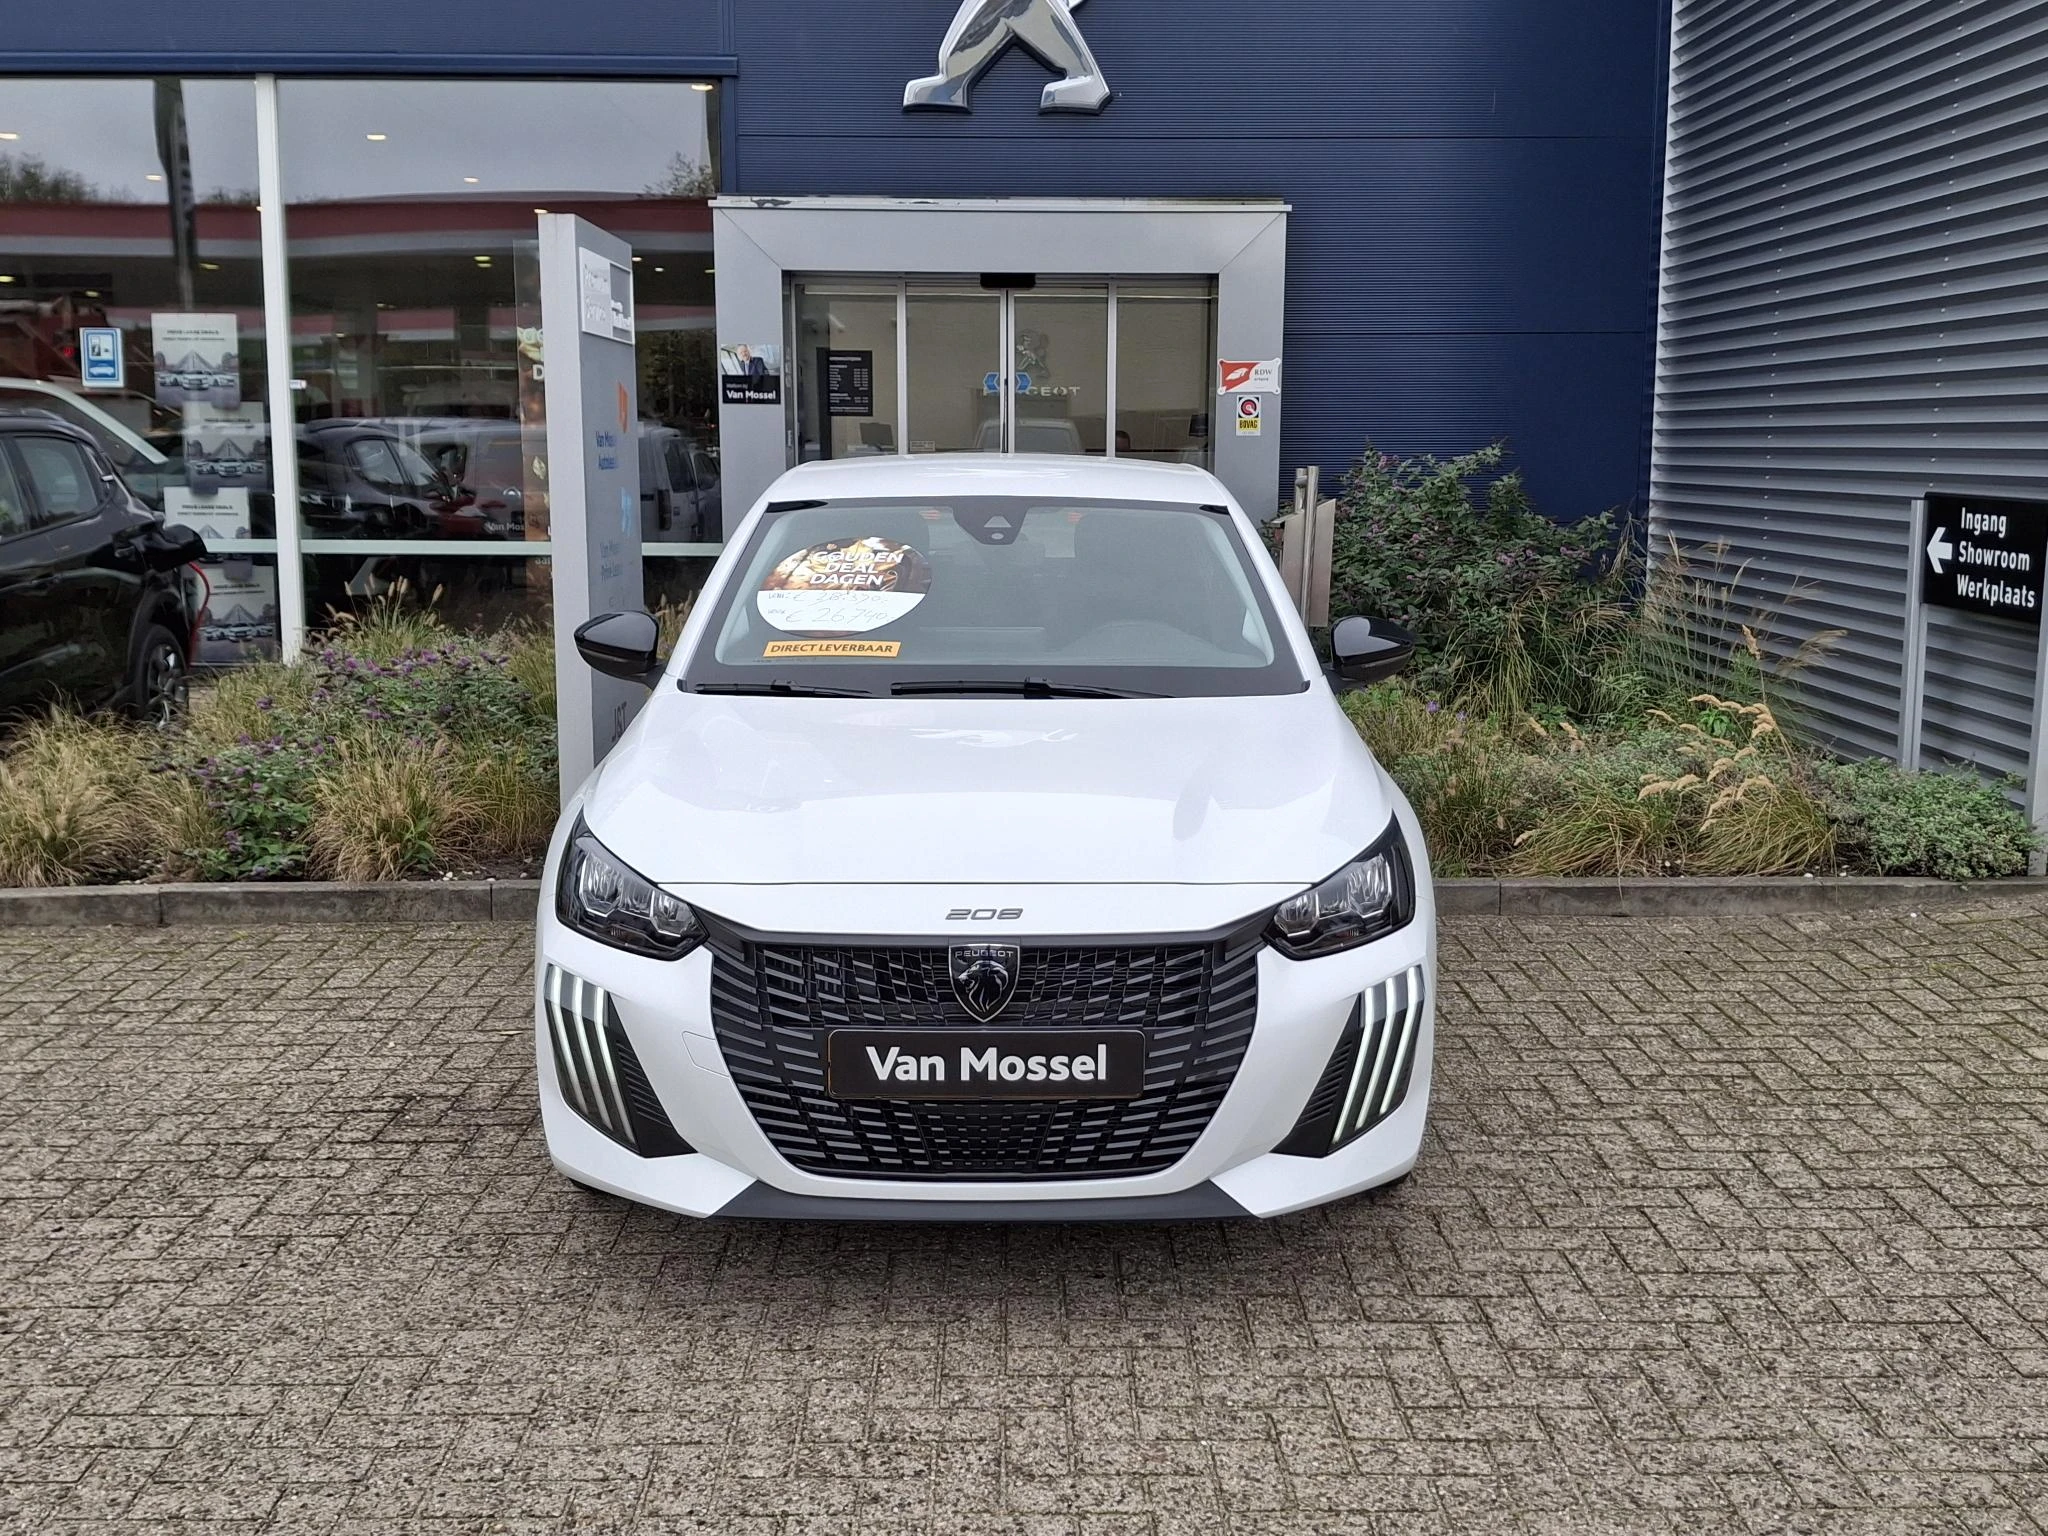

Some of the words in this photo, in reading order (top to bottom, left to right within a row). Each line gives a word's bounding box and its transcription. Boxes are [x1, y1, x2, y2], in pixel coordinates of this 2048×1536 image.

[1254, 368, 1272, 376] RDW
[726, 389, 744, 400] Van
[745, 389, 776, 400] Mossel
[1239, 419, 1258, 429] BOVAG
[1960, 507, 2007, 538] Ingang
[813, 551, 904, 563] GOUDEN
[1958, 541, 2030, 571] Showroom
[824, 562, 879, 574] DEAL
[810, 574, 884, 586] DAGEN
[1957, 574, 2036, 608] Werkplaats
[770, 643, 818, 653] DIRECT
[818, 643, 893, 653] LEVERBAAR
[945, 907, 1024, 921] 208
[954, 949, 1014, 958] PEUGEOT
[865, 1045, 945, 1081] Van
[960, 1043, 1107, 1081] Mossel
